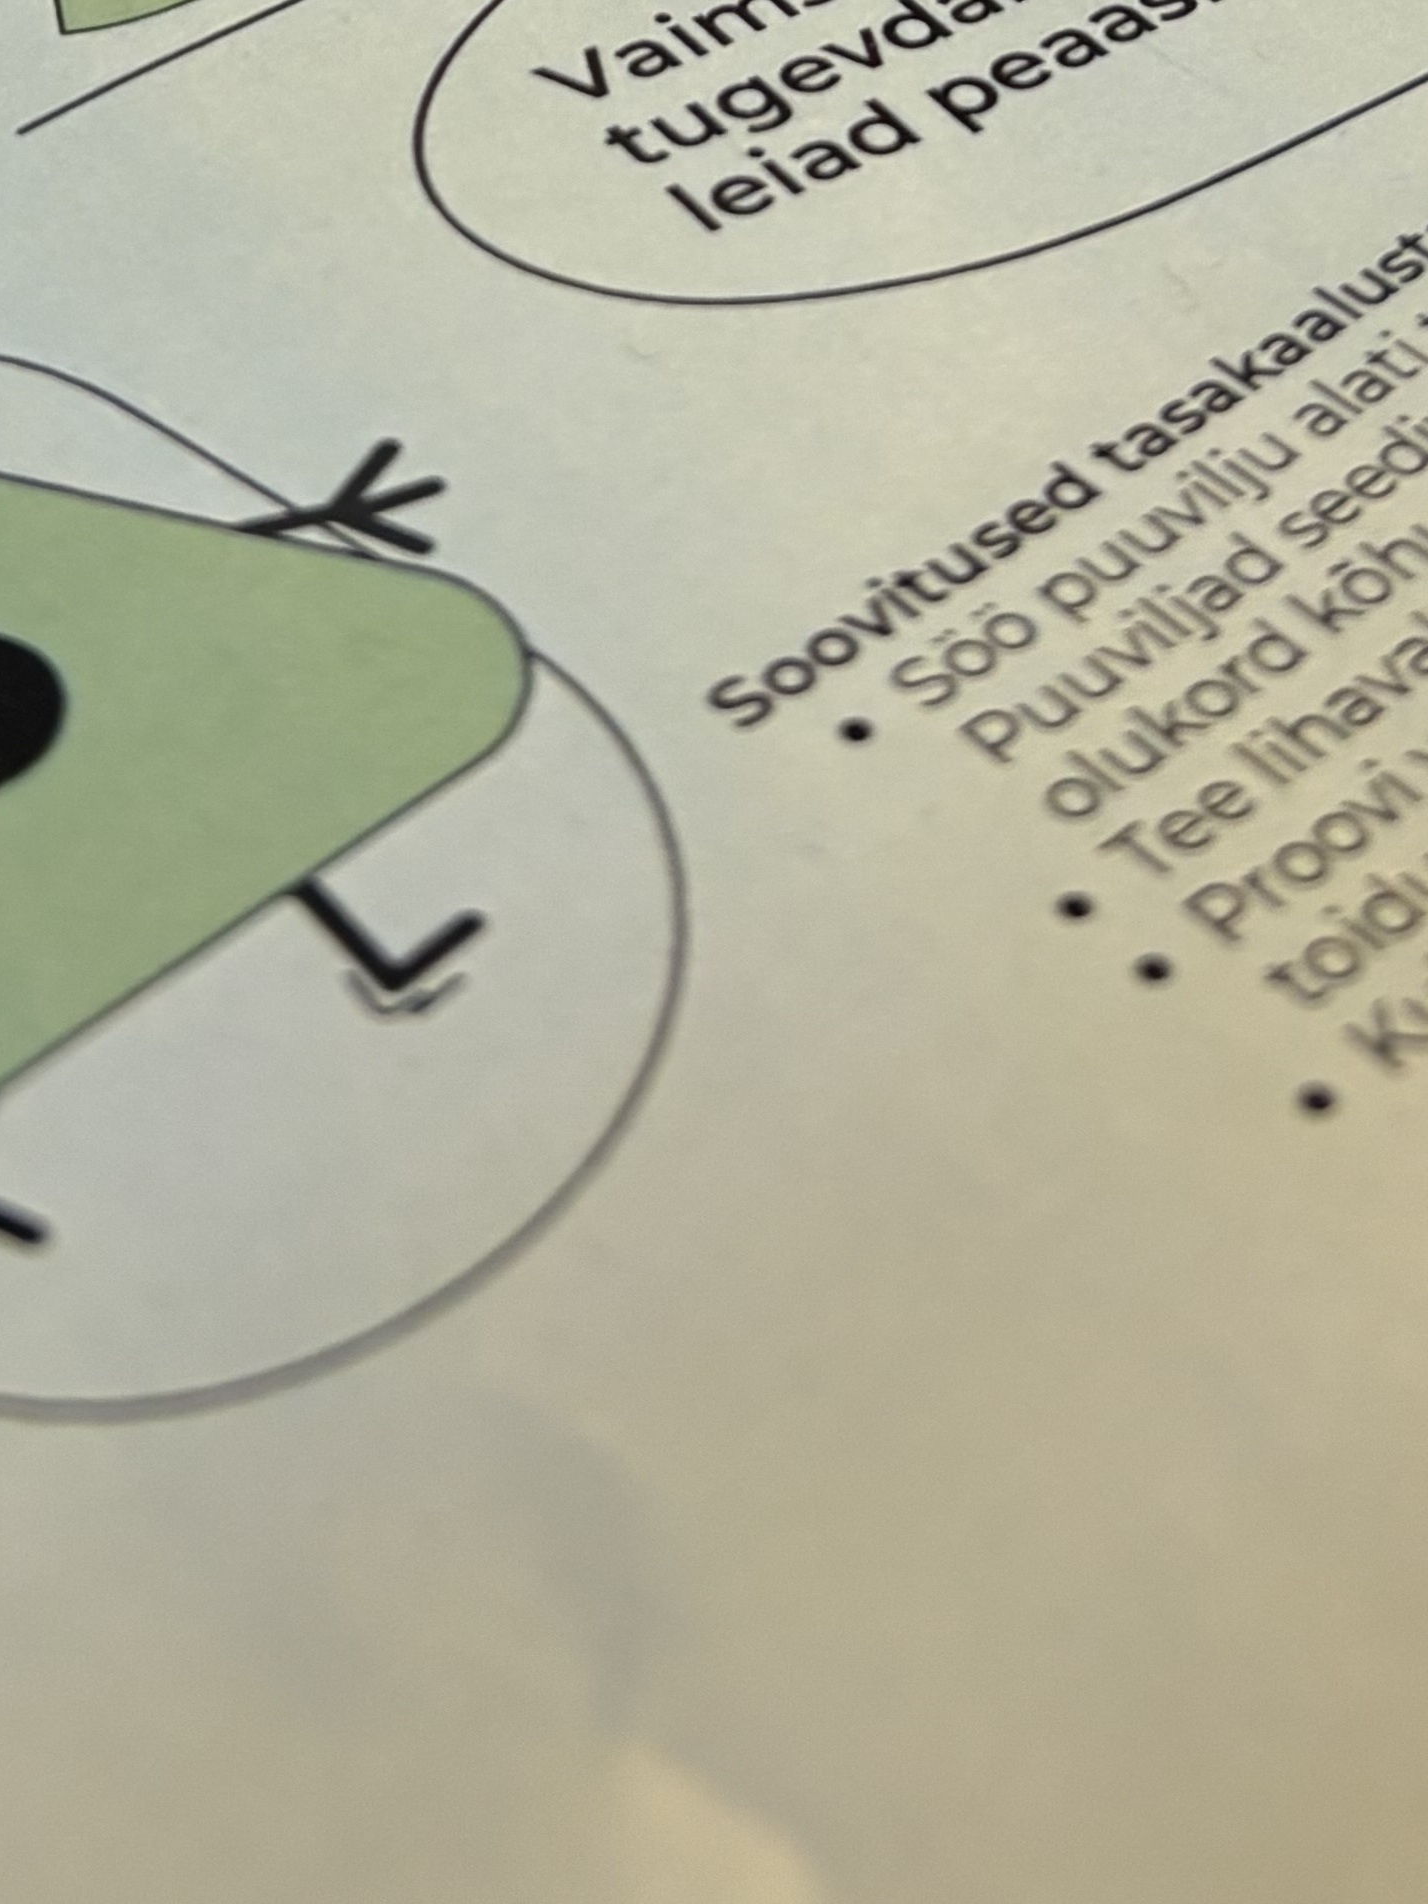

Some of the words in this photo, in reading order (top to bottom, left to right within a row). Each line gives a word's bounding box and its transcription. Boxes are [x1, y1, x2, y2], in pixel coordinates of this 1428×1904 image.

[663, 97, 923, 232] leiad
[708, 460, 1103, 729] Soovitused
[888, 601, 1037, 708] Söö
[1035, 431, 1301, 622] puuvilju
[957, 532, 1285, 763] Puuviljad
[1046, 617, 1307, 821] olukord
[1096, 778, 1258, 876] Tee
[1181, 758, 1423, 945] Proovi
